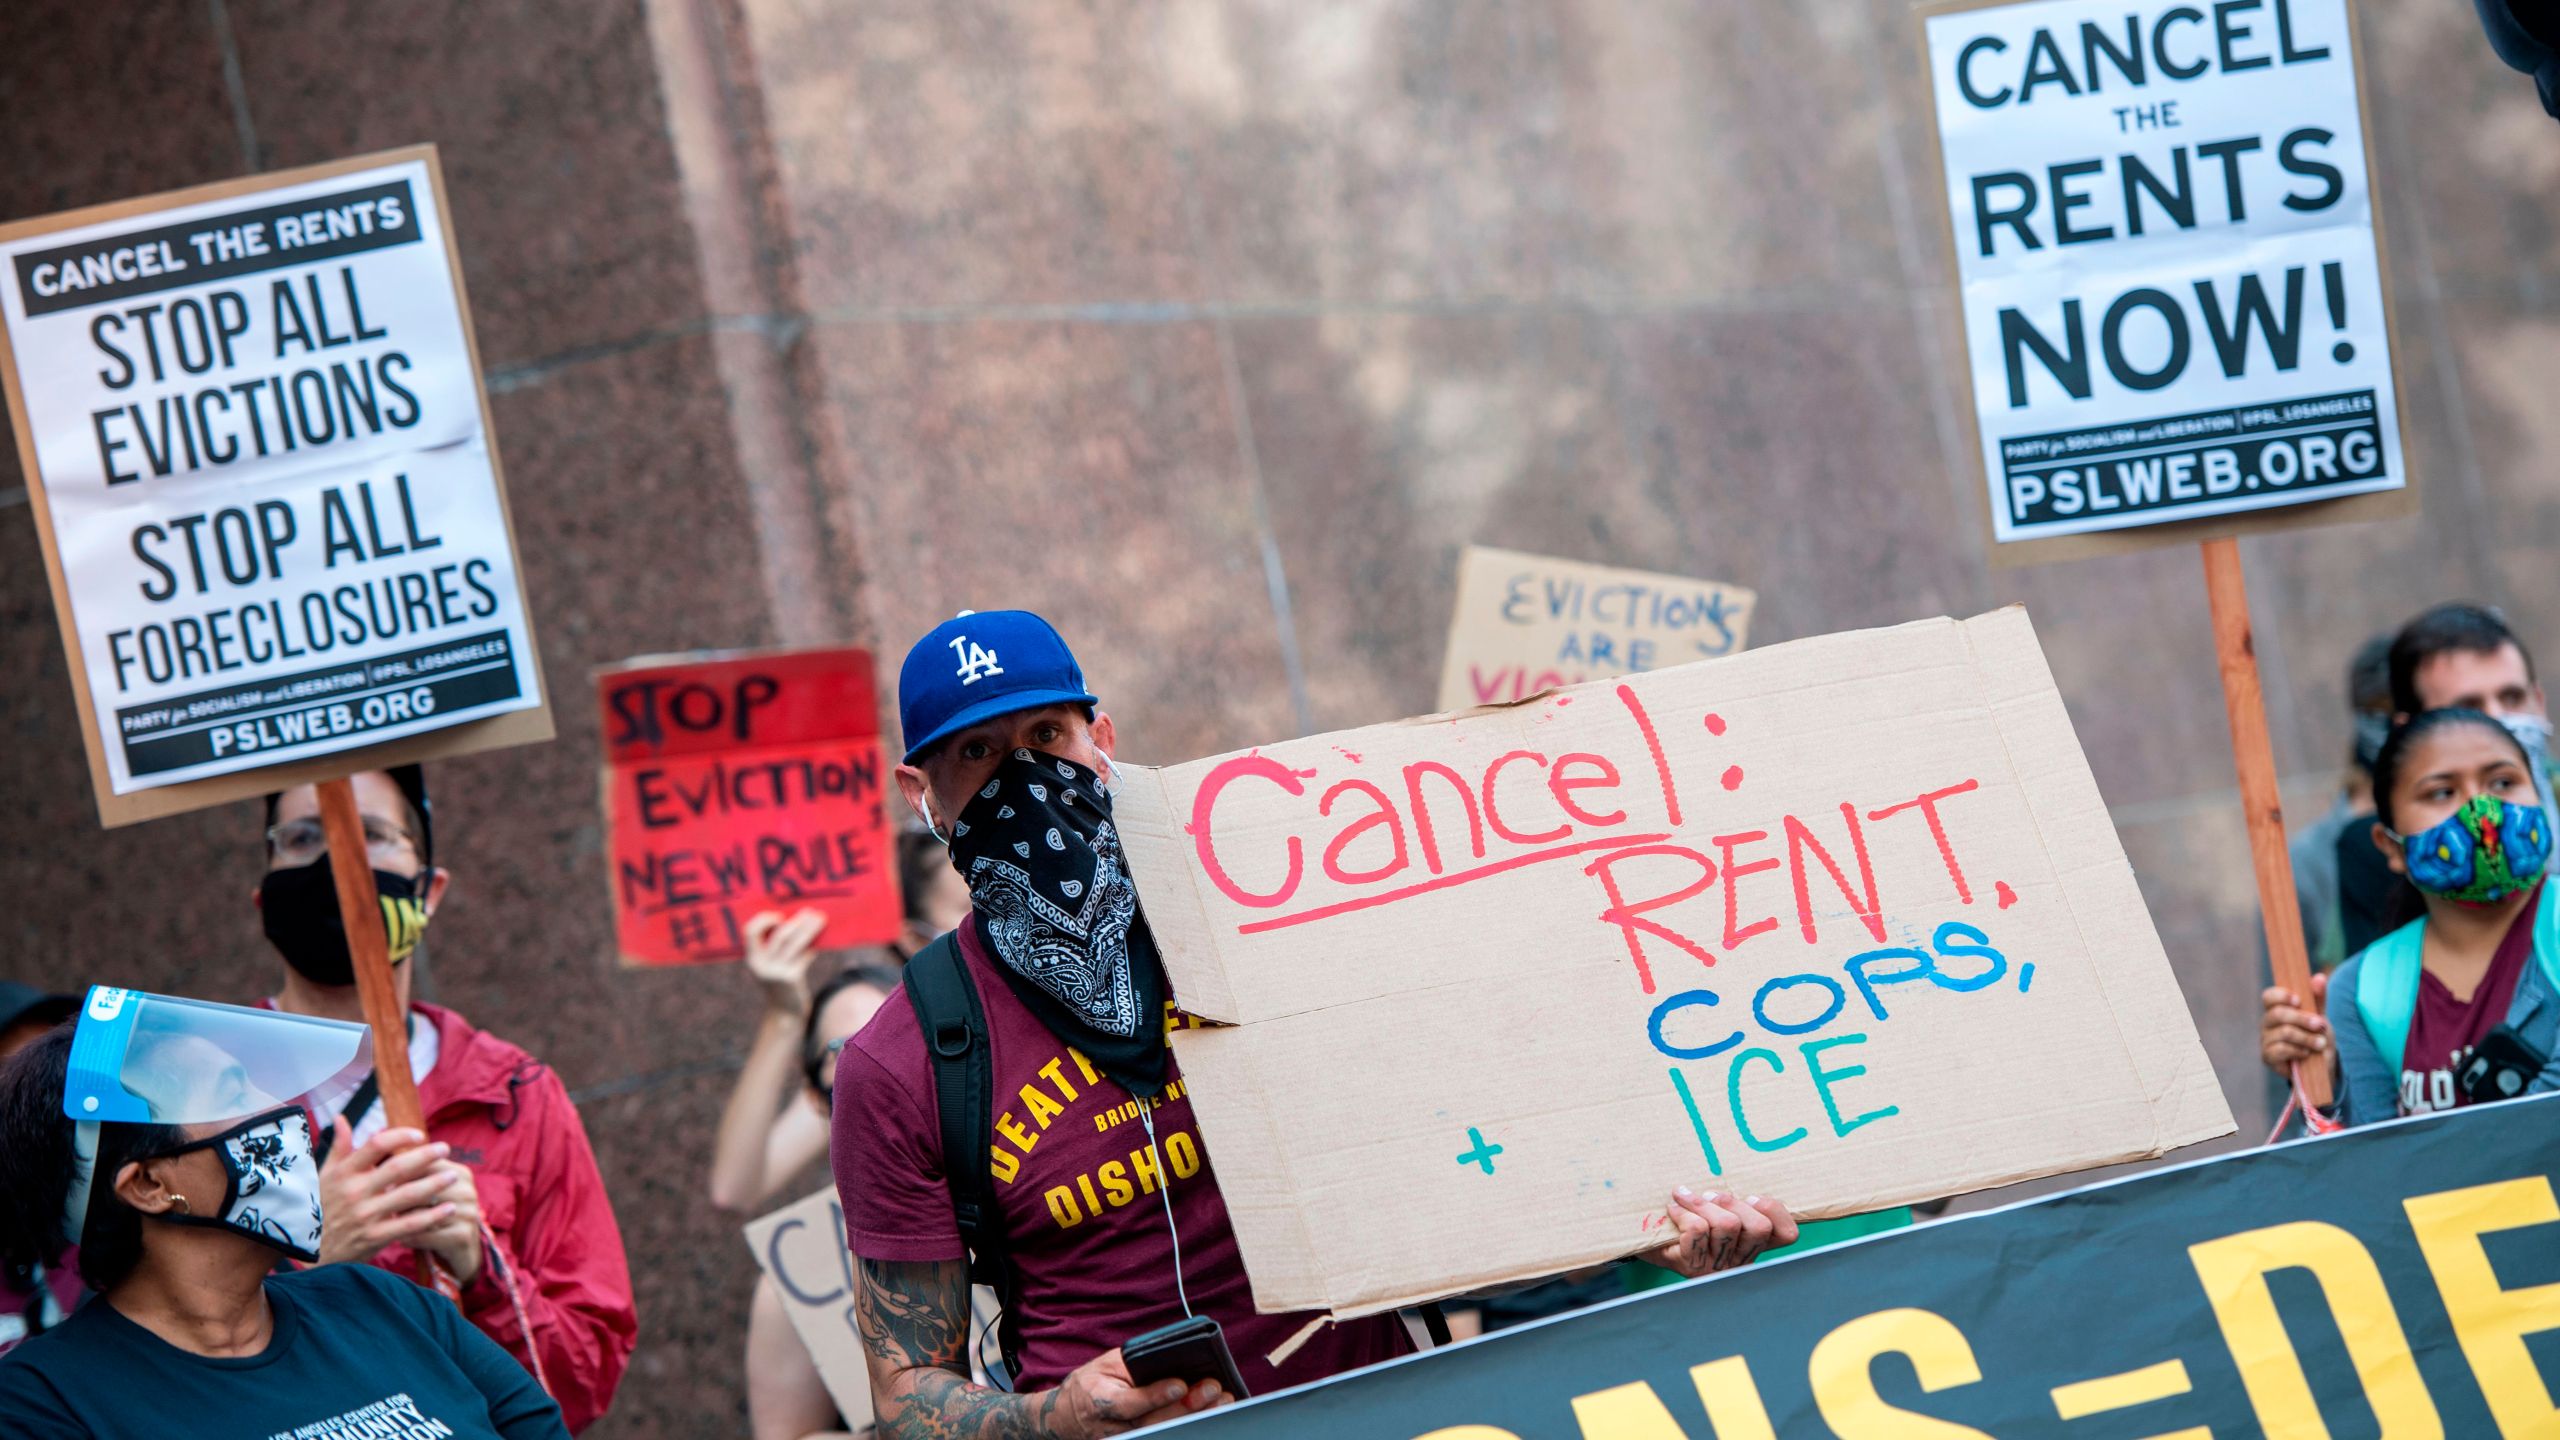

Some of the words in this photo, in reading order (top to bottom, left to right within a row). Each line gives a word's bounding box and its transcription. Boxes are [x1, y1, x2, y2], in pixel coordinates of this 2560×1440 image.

[1957, 0, 2330, 109] CANCEL
[2113, 101, 2181, 133] THE
[1971, 127, 2345, 256] RENTS
[31, 242, 186, 297] CANCEL
[190, 223, 270, 267] THE
[276, 197, 406, 250] RENTS
[90, 290, 250, 390] STOP
[269, 267, 386, 358] ALL
[1998, 261, 2355, 409] NOW!
[92, 353, 421, 485] EVICTIONS
[2005, 440, 2049, 459] PARTY
[2010, 429, 2378, 520] PSLWEB.ORG
[131, 497, 298, 601] STOP
[320, 473, 441, 569] ALL
[108, 558, 499, 693] FORECLOSURES
[949, 635, 1004, 687] LA
[1501, 574, 1741, 656] EVICTIONS
[1557, 631, 1657, 671] ARE
[122, 709, 170, 732] PARTY
[188, 691, 262, 718] SOCIALISM
[283, 670, 366, 700] LIBERATION
[210, 687, 435, 756] PSLWEB.ORG
[608, 674, 780, 746] STOP
[1185, 685, 1744, 908] Cancel:
[621, 842, 749, 908] NEW
[1648, 921, 2034, 1059] COPS,
[1669, 1033, 1899, 1175] ICE
[1044, 1124, 1201, 1229] DISHO
